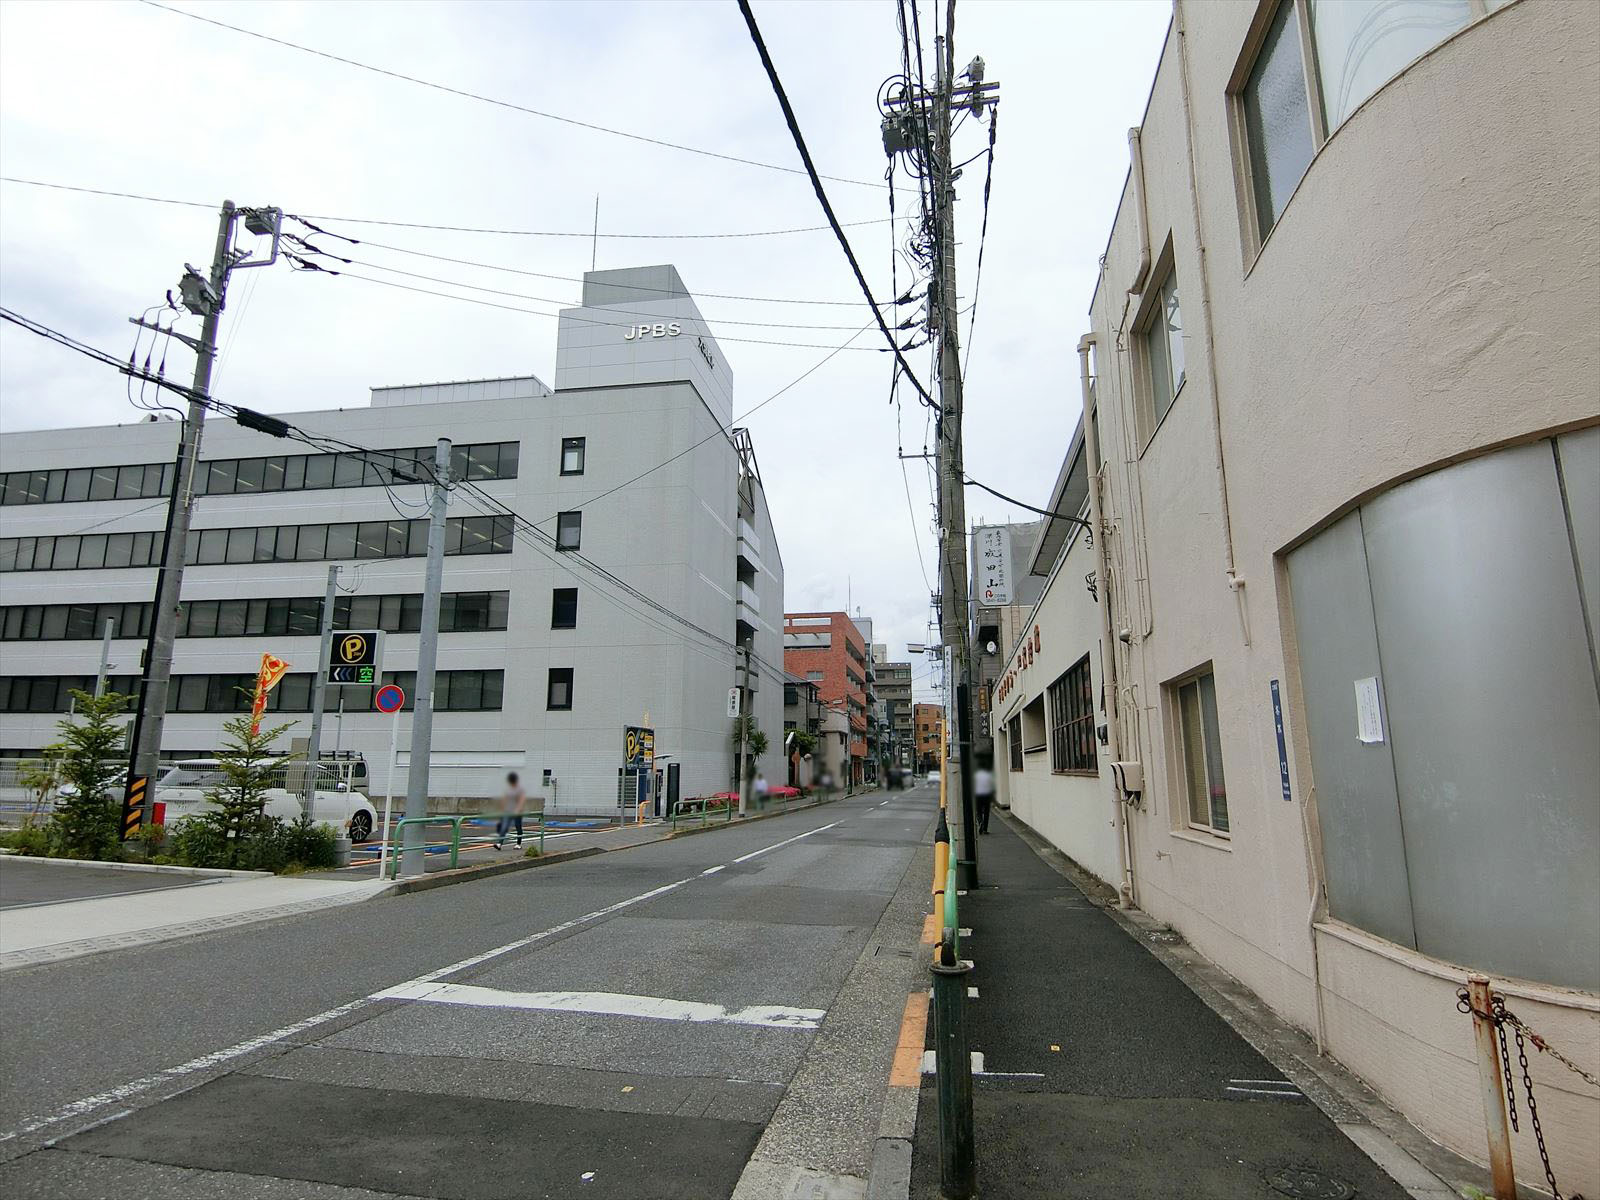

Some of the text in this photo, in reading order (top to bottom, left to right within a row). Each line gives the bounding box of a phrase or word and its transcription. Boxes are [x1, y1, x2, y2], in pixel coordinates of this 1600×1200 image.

[624, 322, 682, 340] JPBS
[345, 638, 362, 660] P
[358, 666, 374, 682] 空
